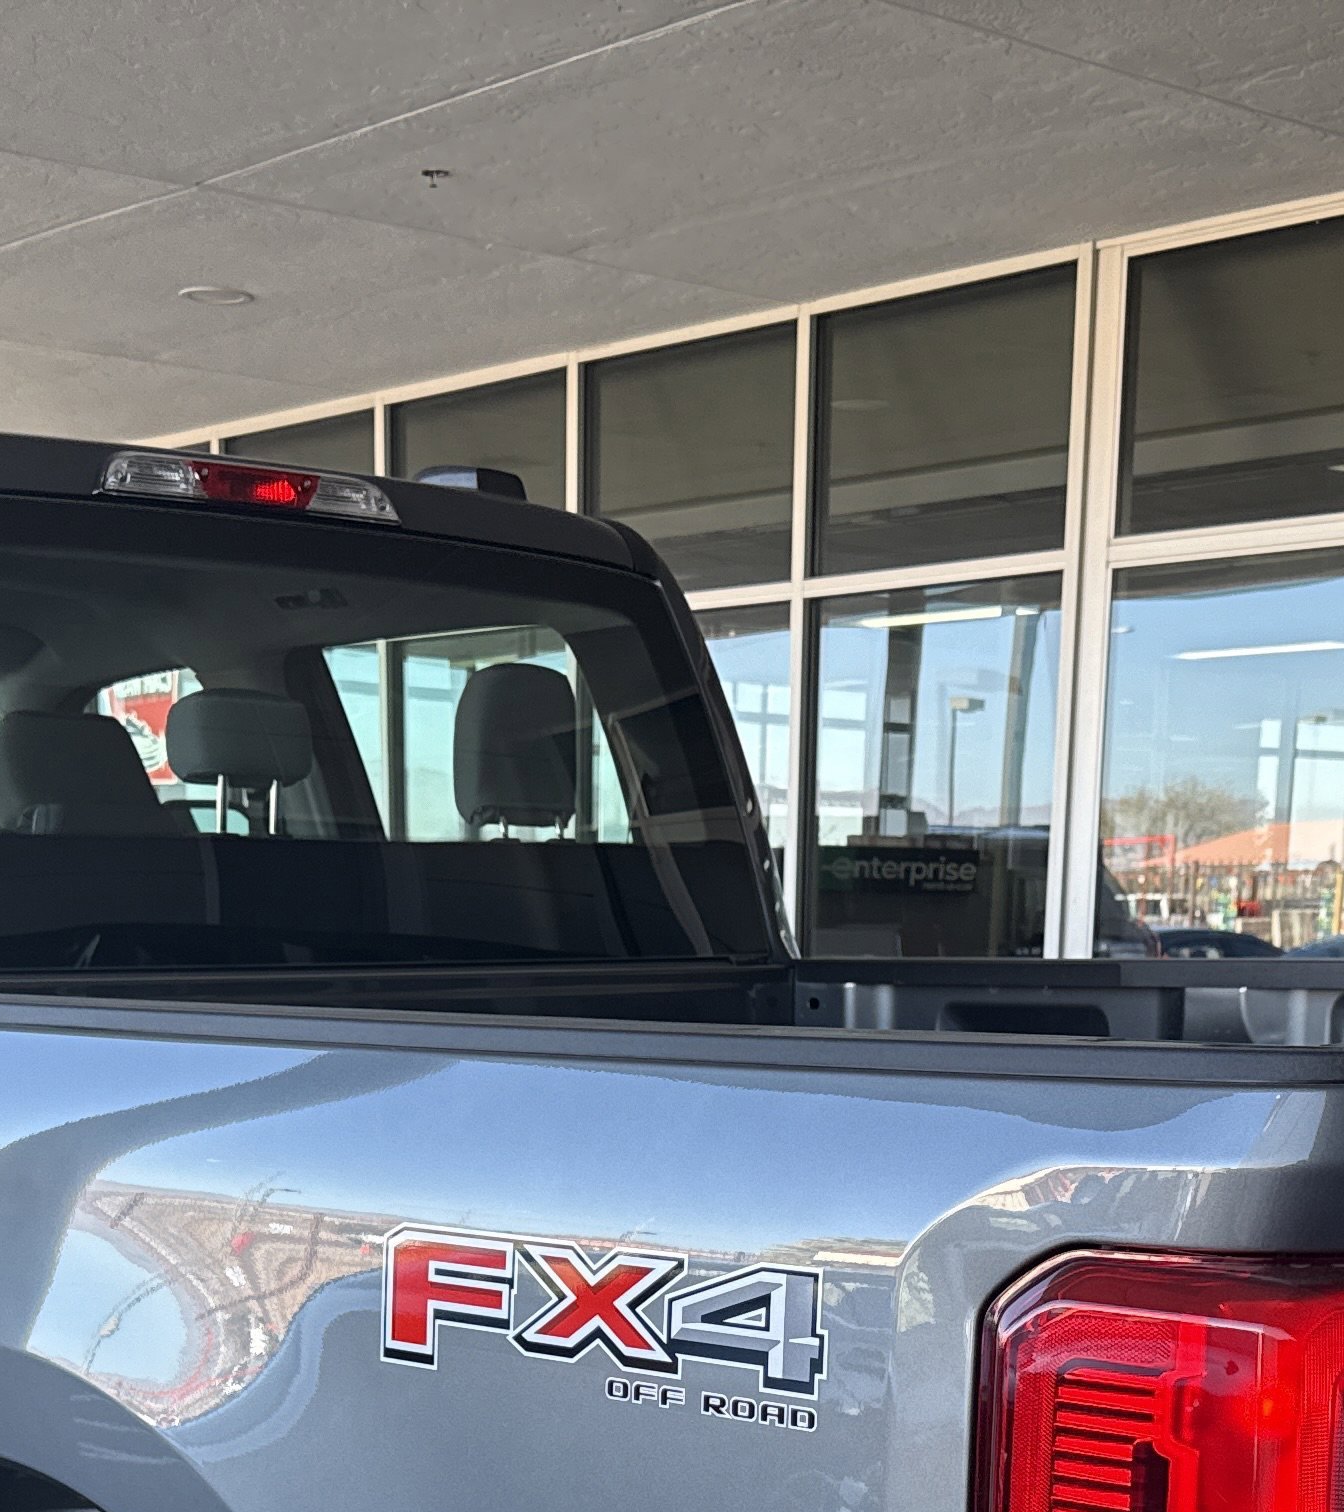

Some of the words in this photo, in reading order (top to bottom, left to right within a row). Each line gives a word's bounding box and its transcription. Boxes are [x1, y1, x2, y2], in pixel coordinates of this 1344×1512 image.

[821, 856, 977, 887] enterprise
[381, 1222, 827, 1400] FX4
[605, 1376, 686, 1409] OFF
[700, 1390, 818, 1433] ROAD
